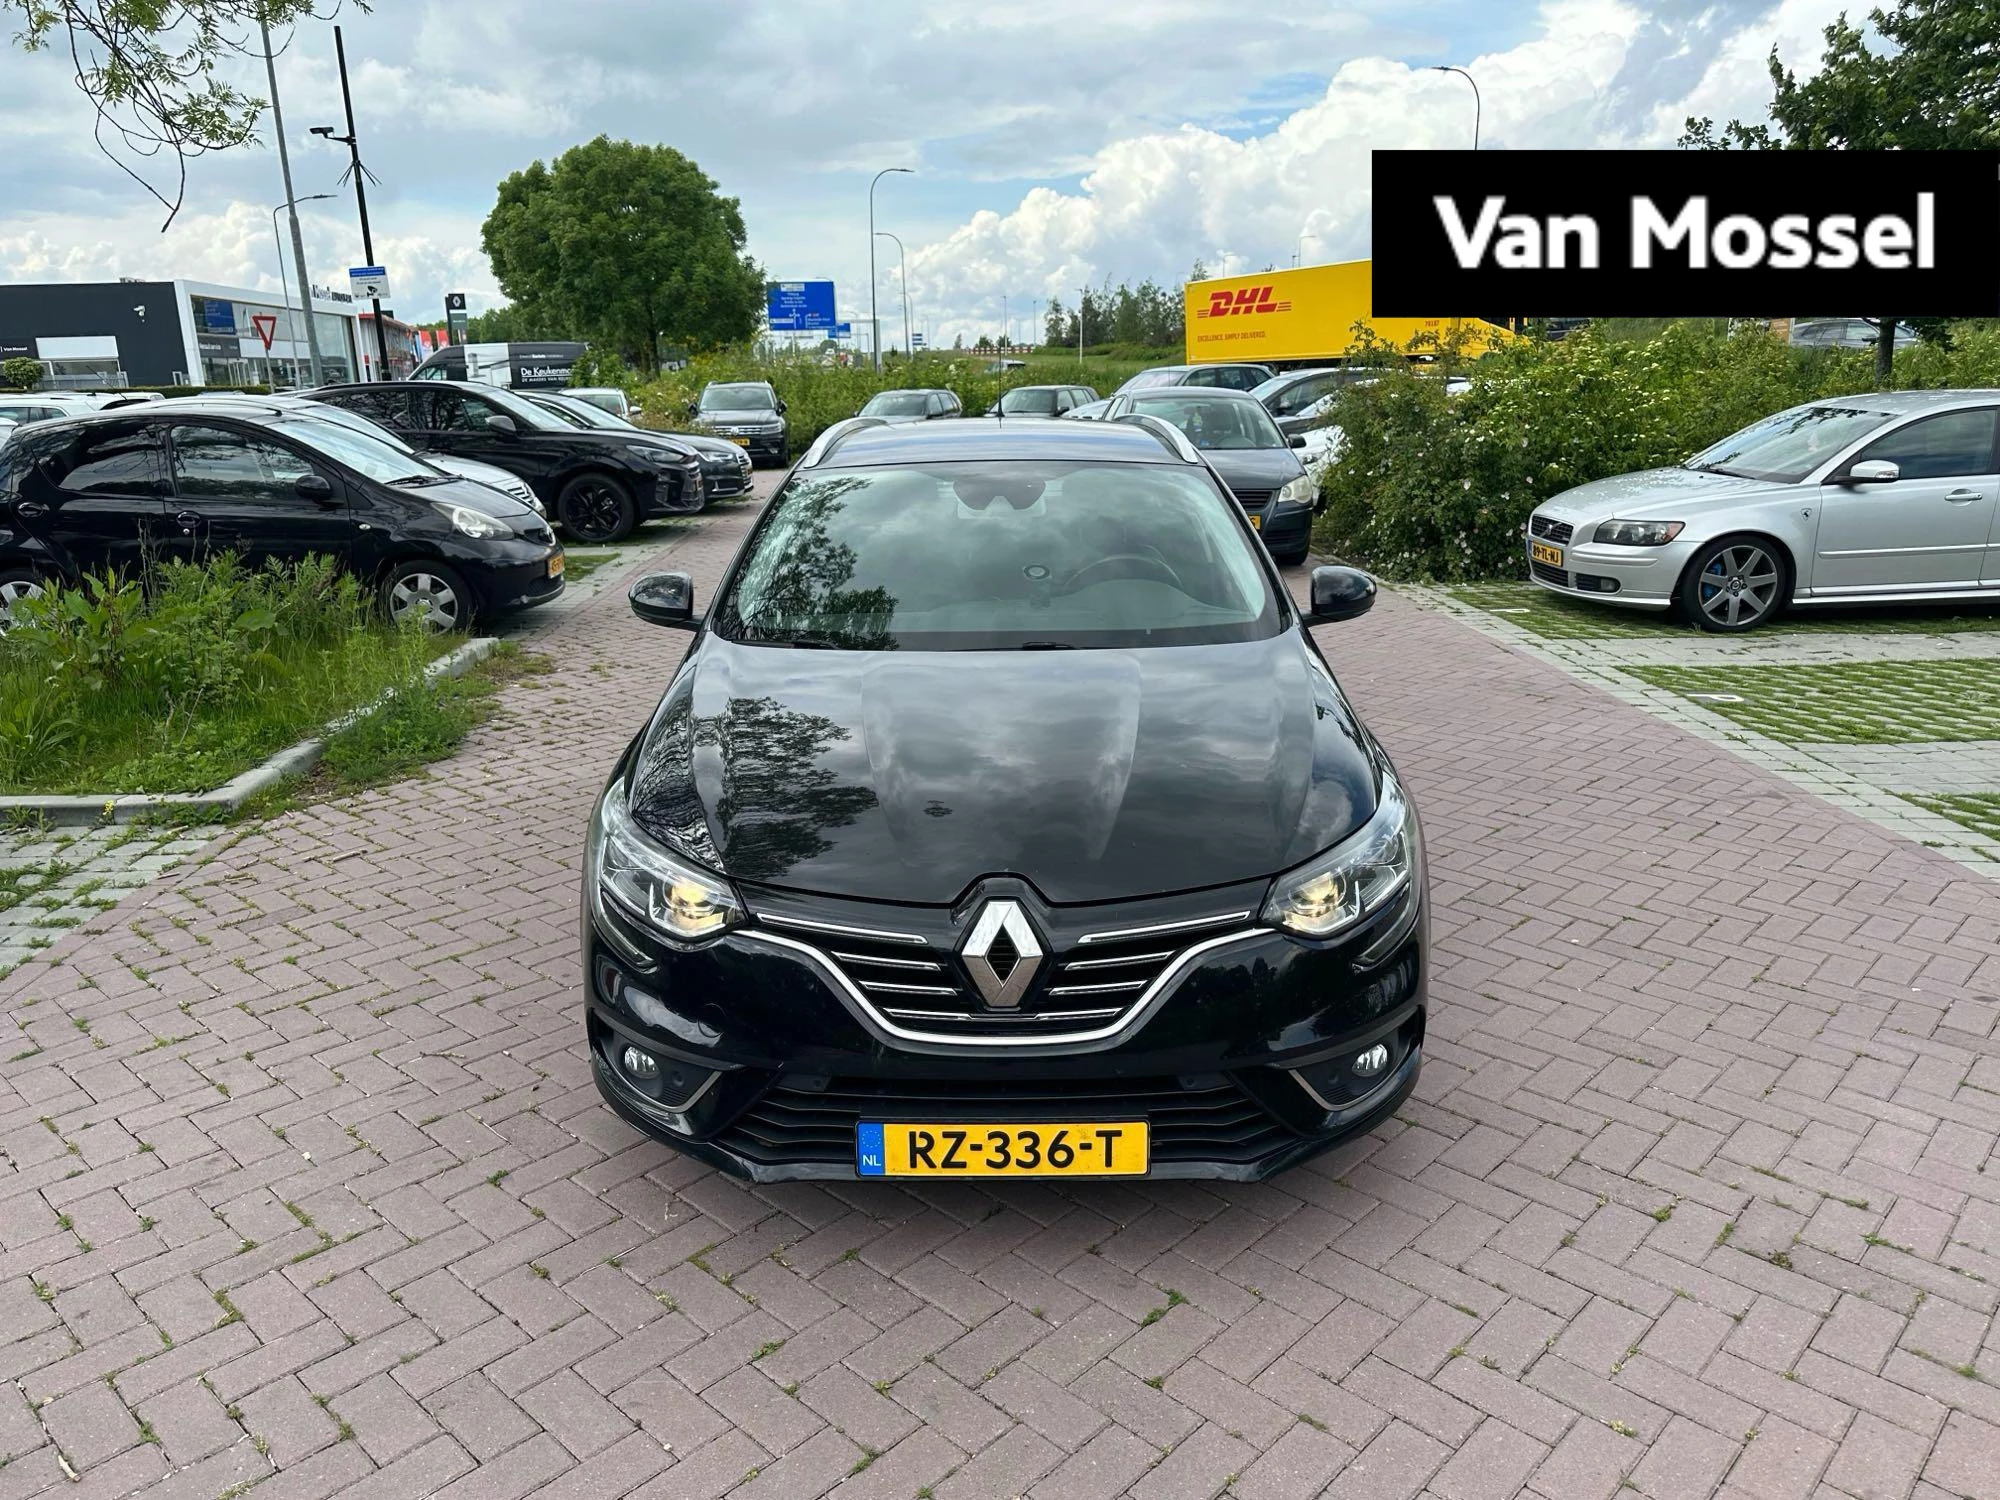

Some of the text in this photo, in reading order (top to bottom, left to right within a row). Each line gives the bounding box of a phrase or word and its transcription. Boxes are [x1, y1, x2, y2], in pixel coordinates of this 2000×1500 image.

[1209, 286, 1278, 317] DHL
[520, 367, 533, 376] De
[862, 1129, 1122, 1169] NL RZ-336-T
